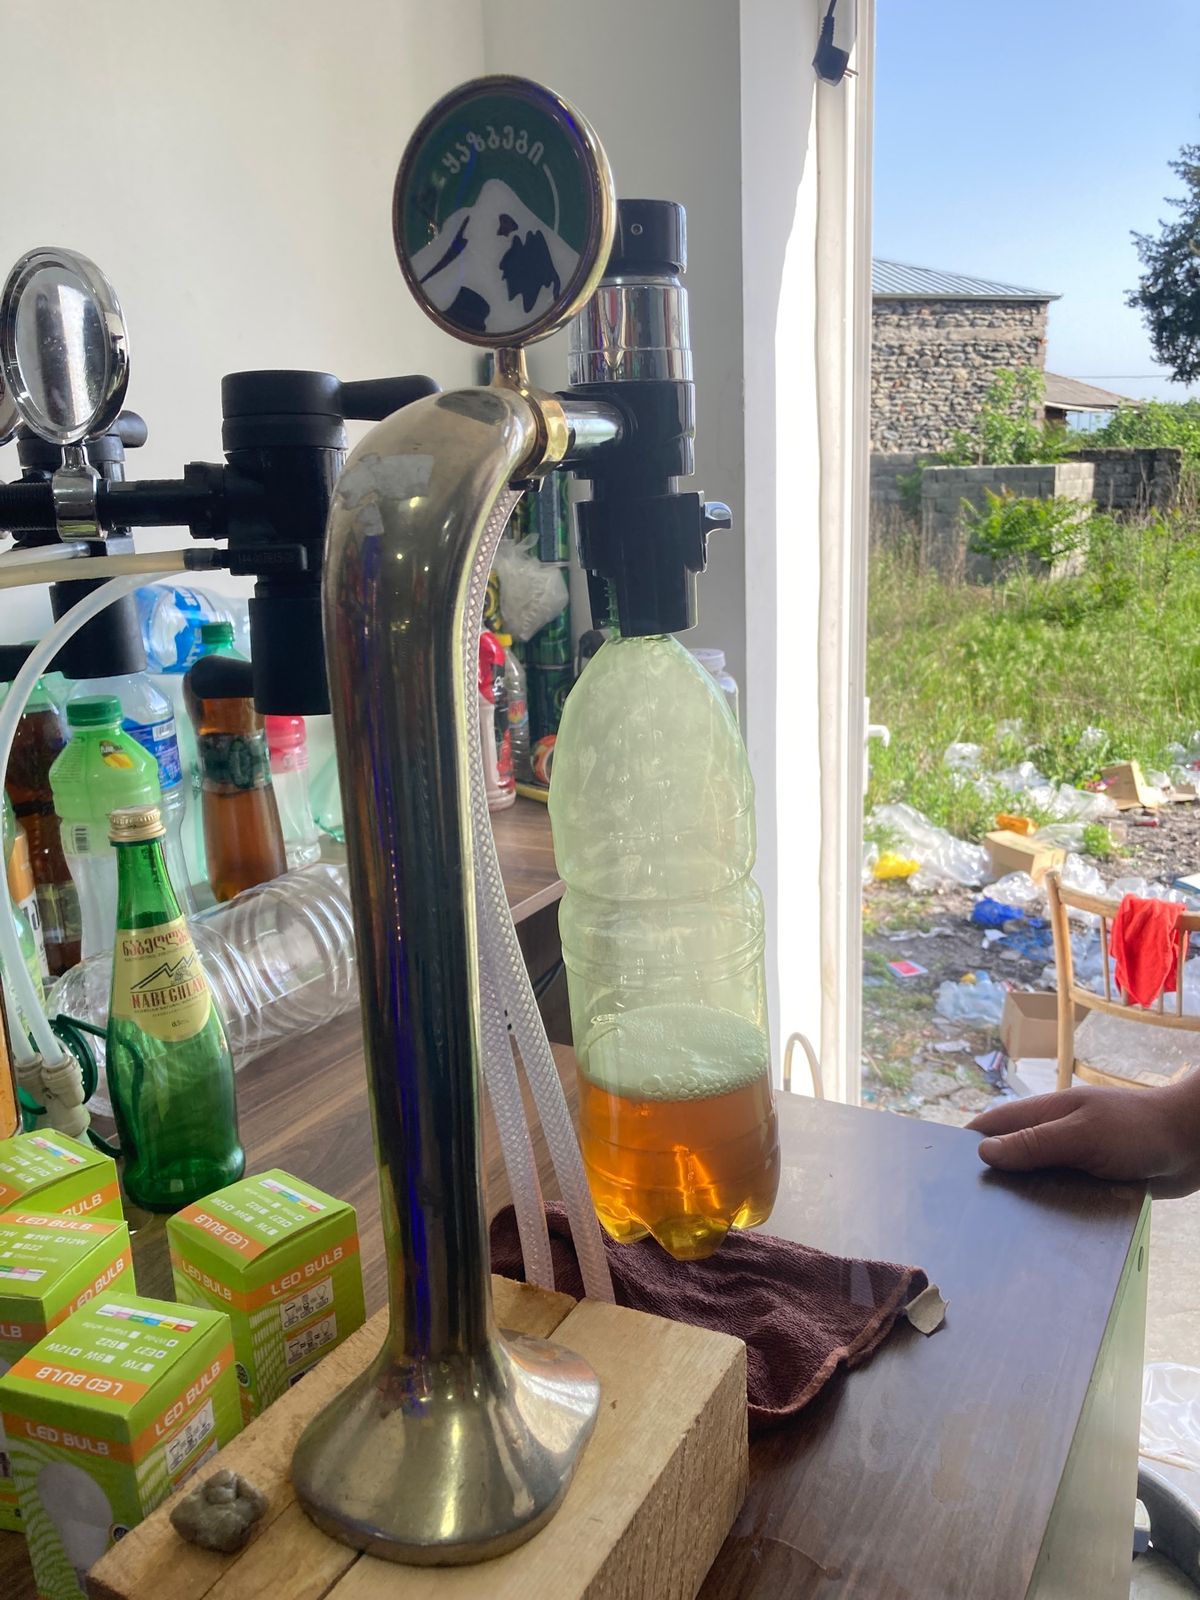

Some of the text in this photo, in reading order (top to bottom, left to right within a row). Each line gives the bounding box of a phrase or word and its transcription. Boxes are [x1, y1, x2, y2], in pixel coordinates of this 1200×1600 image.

[441, 124, 545, 174] ყაზბეგი
[15, 1215, 93, 1231] LED BULB
[193, 1213, 250, 1250] LED BULB
[95, 1258, 125, 1293] BULB
[181, 1260, 233, 1301] LED BULB
[271, 1246, 344, 1295] LED BULB
[35, 1366, 124, 1397] LED BULB
[155, 1400, 185, 1437] LED
[186, 1360, 222, 1404] BULB
[25, 1422, 110, 1455] LED BULB
